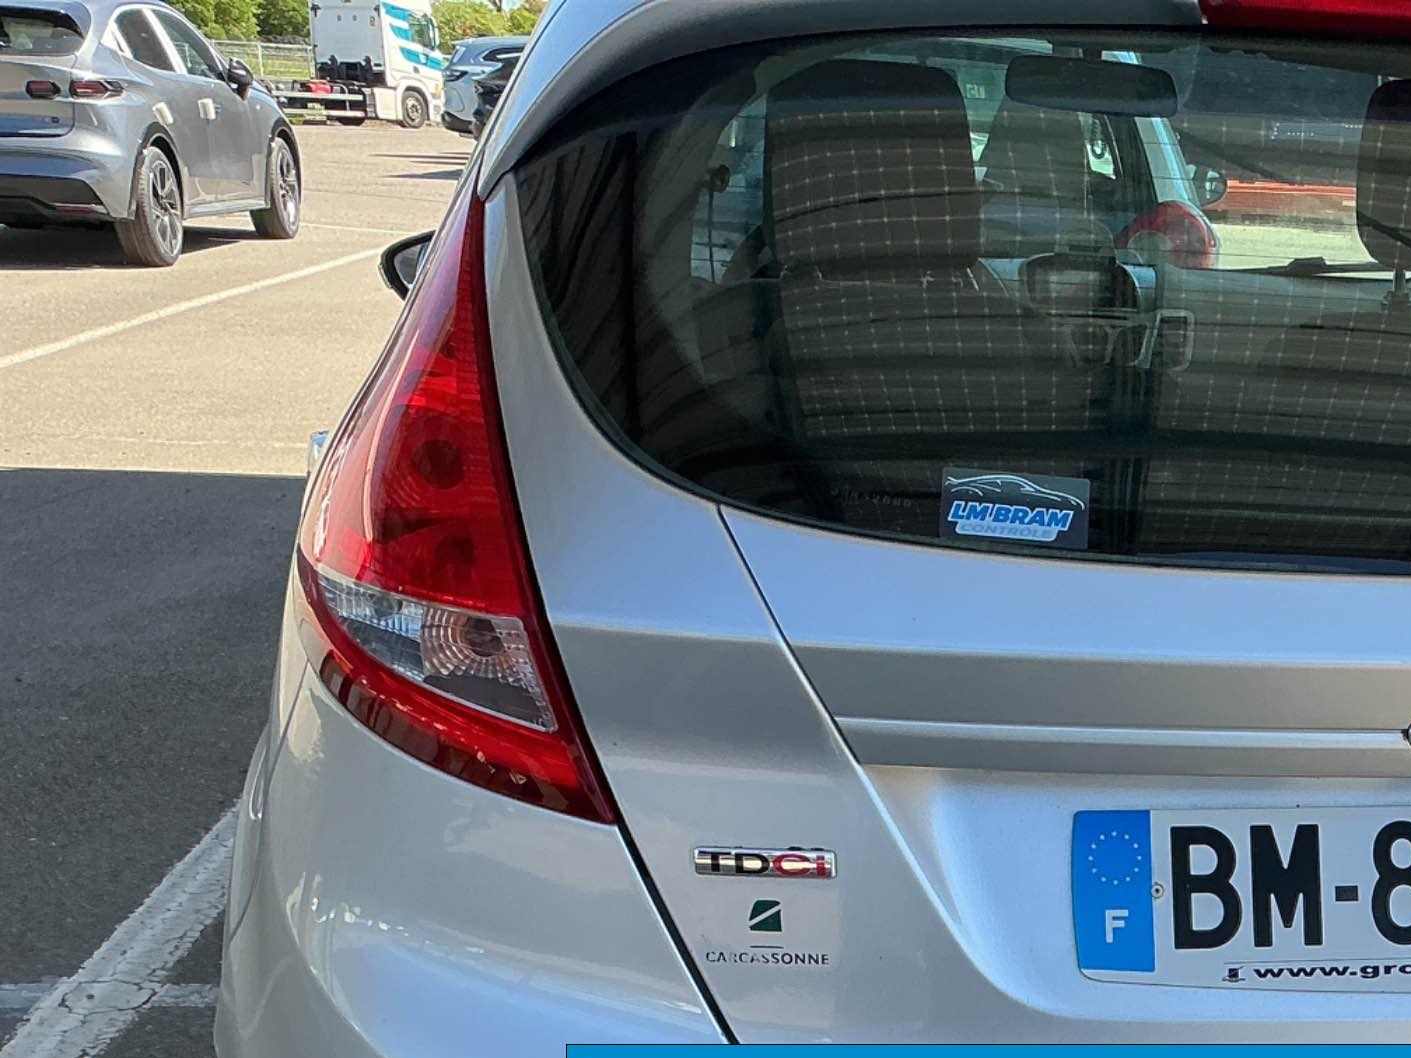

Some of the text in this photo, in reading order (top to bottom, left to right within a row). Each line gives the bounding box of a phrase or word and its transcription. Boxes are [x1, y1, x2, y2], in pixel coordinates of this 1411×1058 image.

[950, 502, 1072, 530] LM BRAM
[1105, 908, 1129, 944] F
[706, 951, 831, 965] CARCASSONNE
